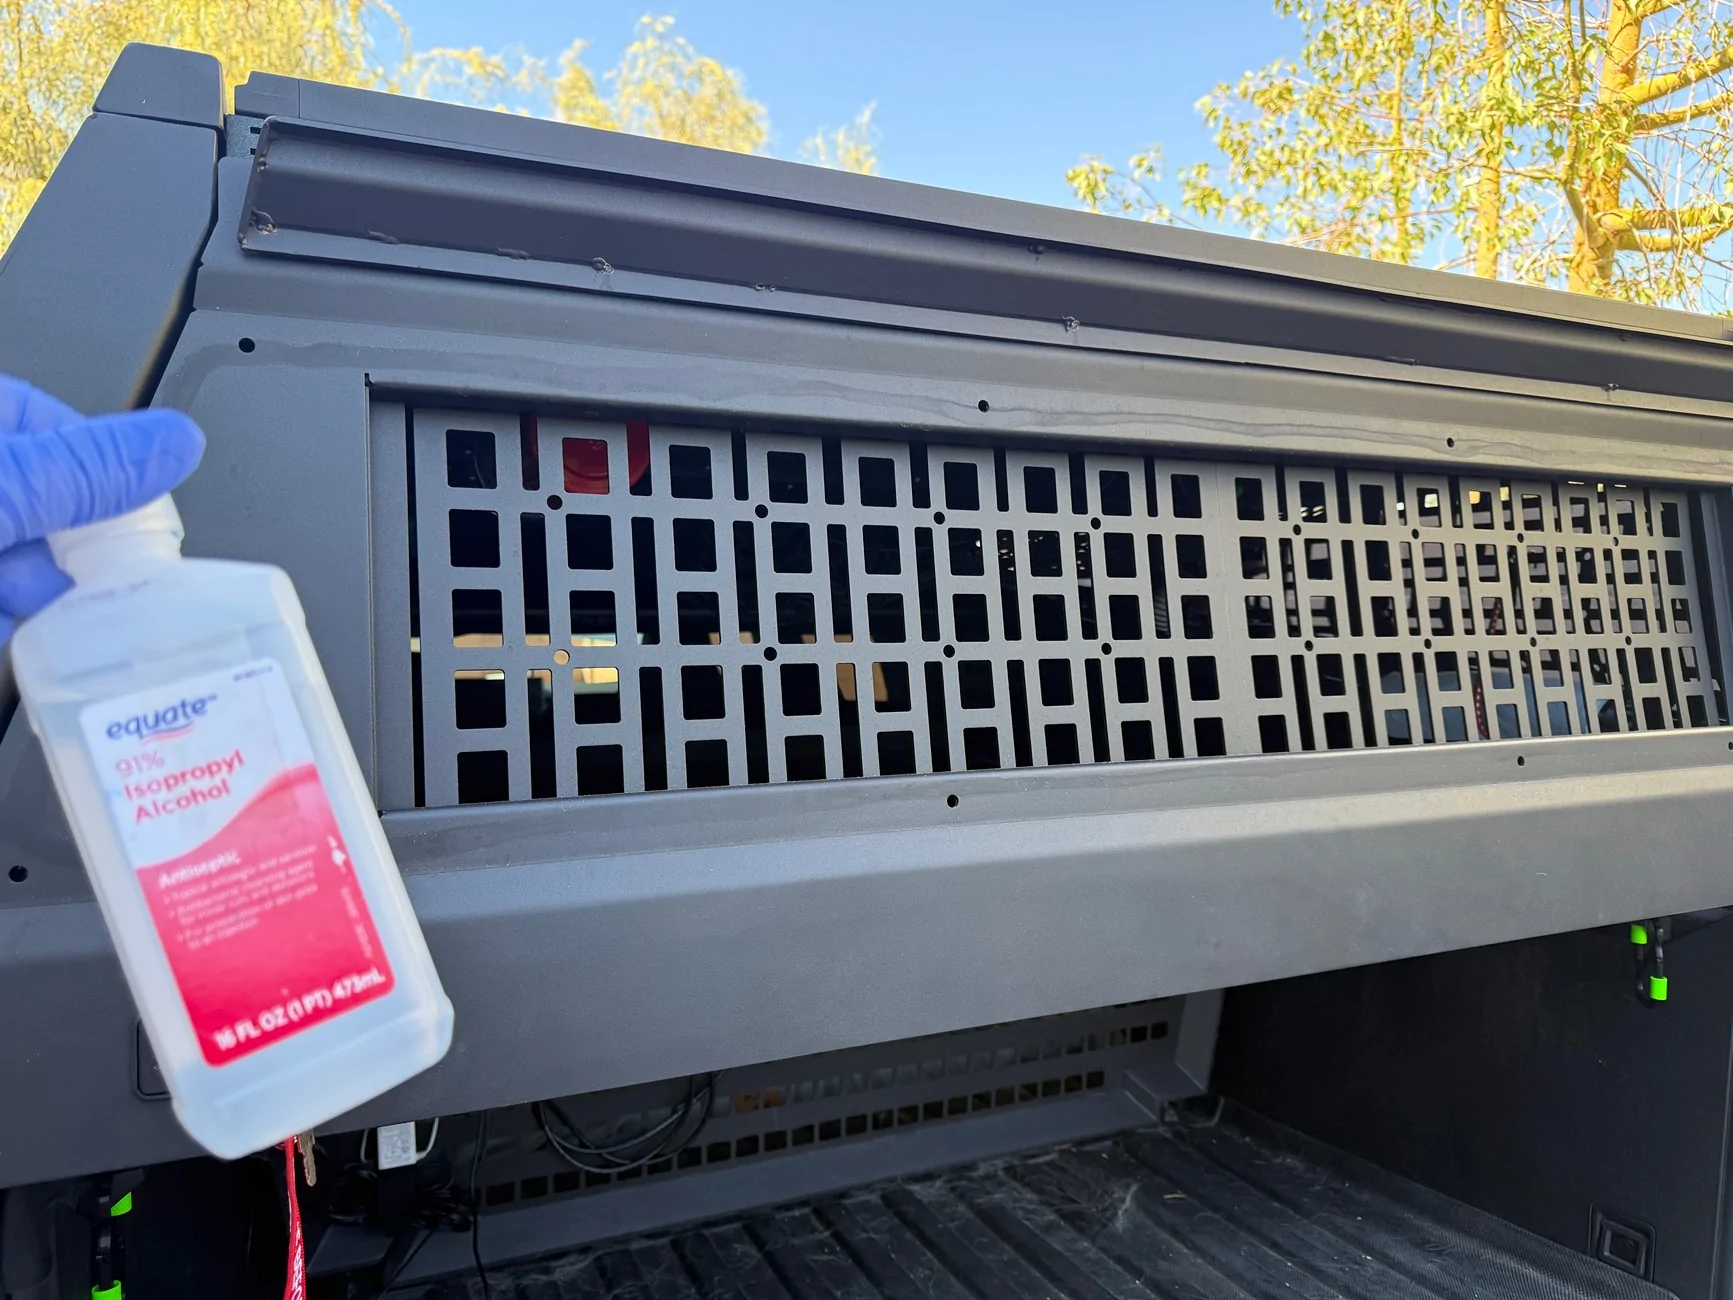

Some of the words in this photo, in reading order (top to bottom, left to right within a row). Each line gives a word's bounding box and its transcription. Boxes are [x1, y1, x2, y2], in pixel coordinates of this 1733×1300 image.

[106, 698, 208, 740] equate
[115, 751, 166, 777] 91%
[124, 749, 245, 801] Isopropyl
[135, 777, 231, 824] Alcohol
[159, 849, 241, 889] Antiseptic
[213, 1026, 237, 1051] 16
[235, 1018, 262, 1043] FL
[258, 1004, 288, 1032] OZ
[332, 965, 386, 999] 473mL
